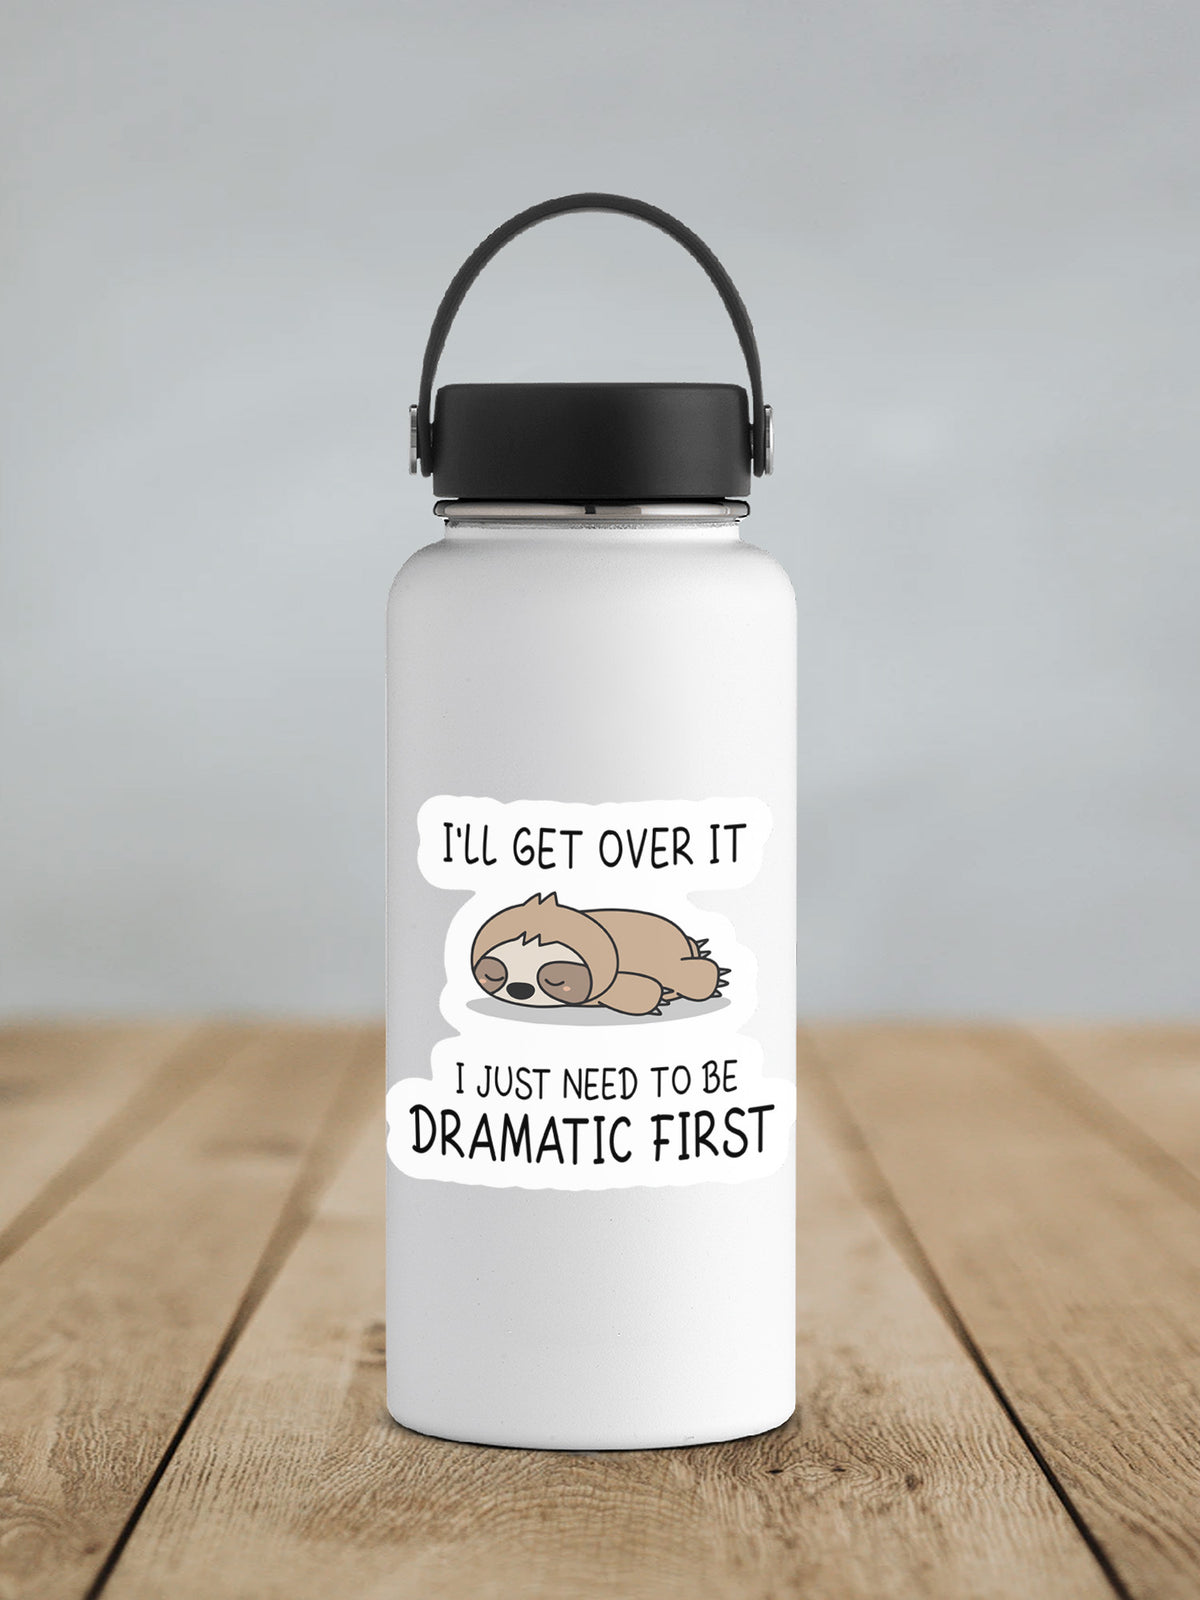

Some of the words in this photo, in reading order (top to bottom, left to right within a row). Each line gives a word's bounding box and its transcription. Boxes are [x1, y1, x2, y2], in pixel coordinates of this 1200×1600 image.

[443, 821, 497, 866] I'LL
[513, 826, 584, 870] GET
[598, 826, 694, 870] OVER
[709, 823, 747, 865] IT
[456, 1061, 465, 1094] I
[476, 1065, 551, 1101] JUST
[563, 1066, 638, 1101] NEED
[650, 1065, 692, 1098] TO
[701, 1059, 738, 1094] BE
[409, 1103, 632, 1166] DRAMATIC
[650, 1104, 775, 1162] FIRST
